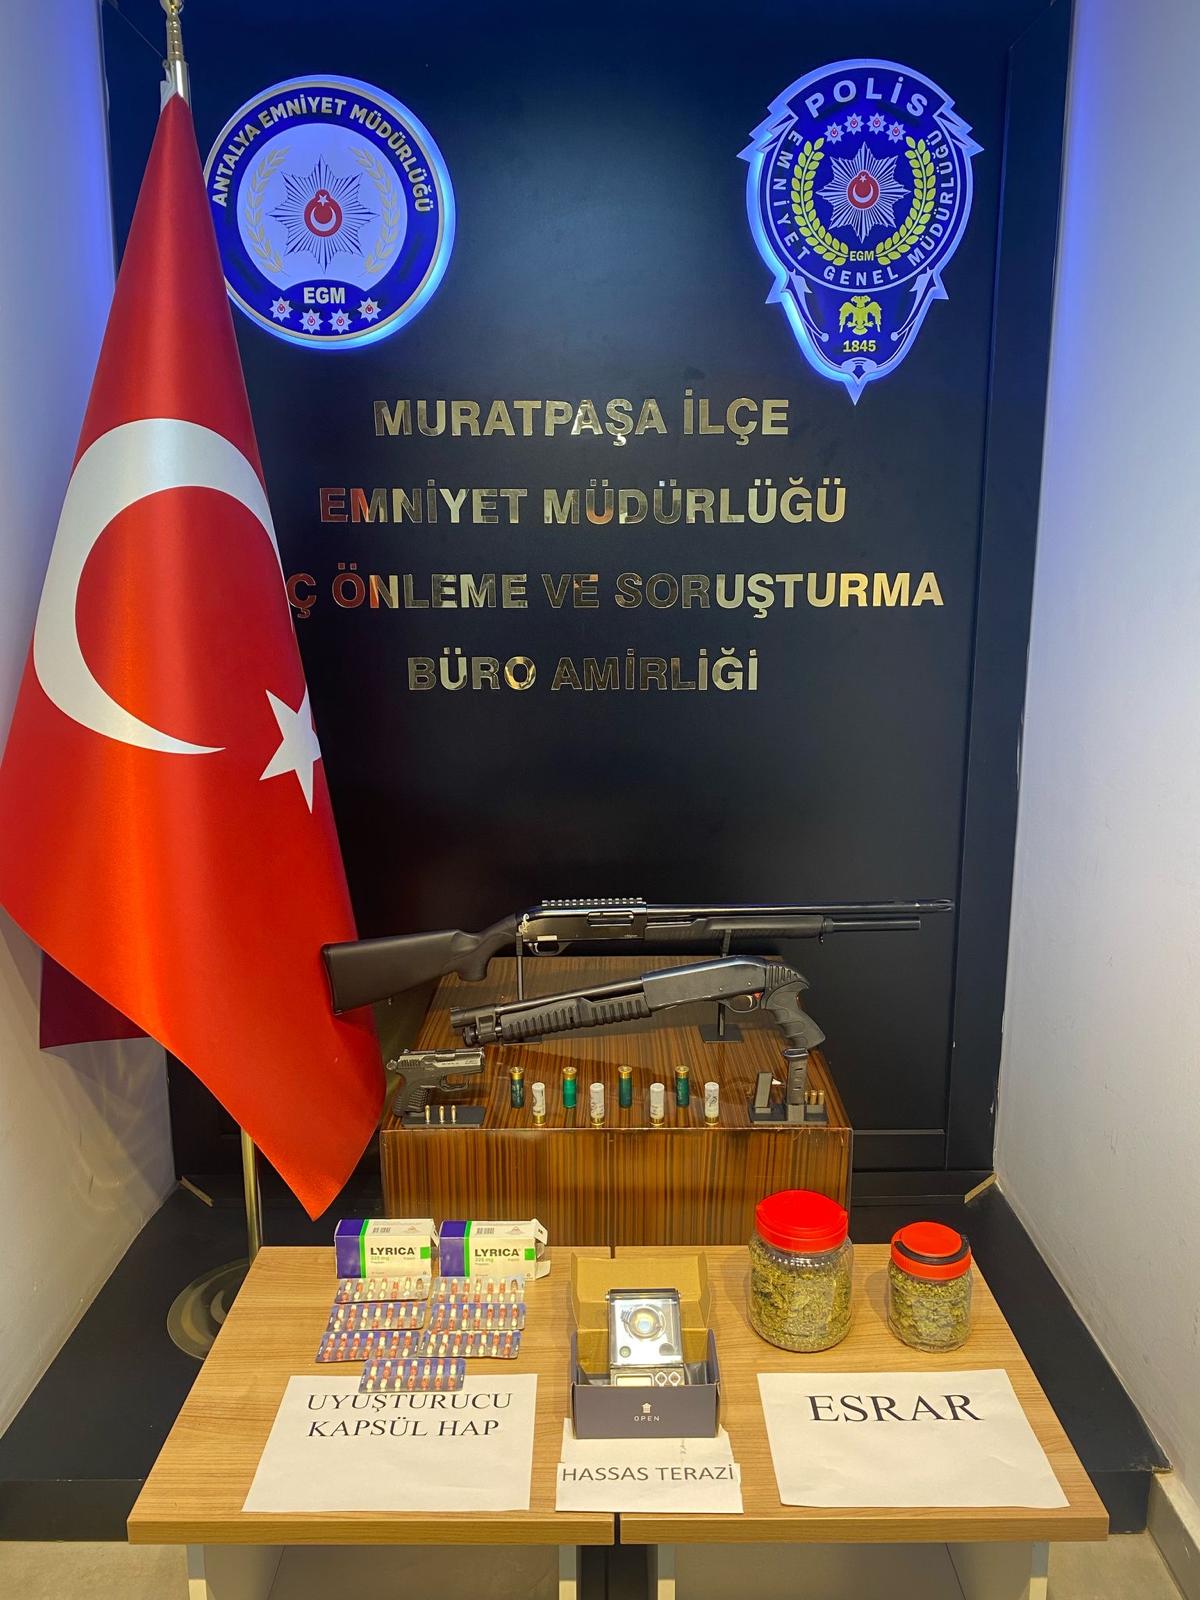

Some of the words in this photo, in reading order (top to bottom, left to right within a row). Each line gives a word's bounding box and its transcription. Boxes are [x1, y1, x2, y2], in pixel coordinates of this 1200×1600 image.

[804, 76, 928, 118] POLİS
[212, 123, 261, 207] ANTALYA
[257, 94, 347, 128] EMNİYET
[349, 104, 434, 212] MÜDÜRLÜĞÜ
[773, 131, 810, 261] EMNİYET
[823, 265, 899, 286] GENEL
[907, 129, 955, 266] MÜDÜRLÜĞÜ
[849, 250, 875, 262] EGM
[303, 287, 346, 304] EGM
[842, 339, 877, 353] 1845
[373, 397, 668, 446] MURATPAŞA
[683, 389, 790, 446] İLÇE
[319, 479, 527, 524] EMNİYET
[542, 476, 847, 525] MÜDÜRLÜĞÜ
[332, 562, 529, 609] ÖNLEME
[541, 574, 600, 609] VE
[614, 571, 945, 620] SORUŞTURMA
[407, 647, 537, 692] BÜRO
[551, 647, 759, 692] AMİRLİĞİ
[370, 1247, 415, 1255] LYRICA
[474, 1248, 520, 1257] LYRICA
[307, 1392, 513, 1412] UYUŞTURUCU
[806, 1394, 985, 1422] ESRAR
[306, 1416, 428, 1437] KAPSÜL
[438, 1419, 500, 1436] HAP
[562, 1466, 649, 1482] HASSAS
[655, 1463, 734, 1481] TERAZİ
